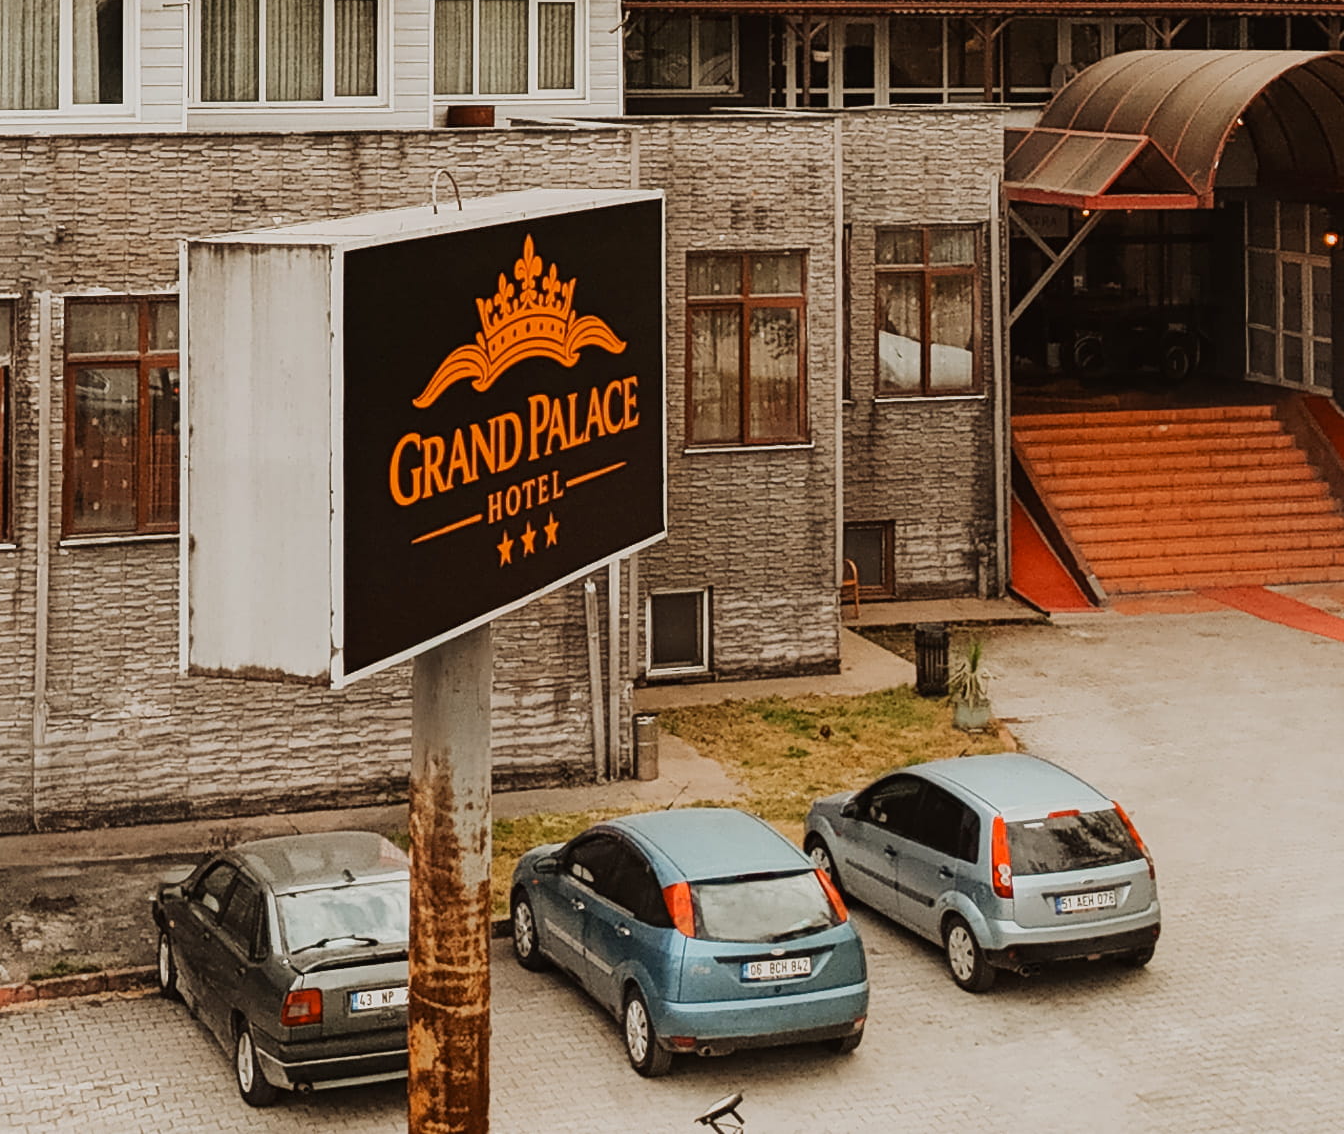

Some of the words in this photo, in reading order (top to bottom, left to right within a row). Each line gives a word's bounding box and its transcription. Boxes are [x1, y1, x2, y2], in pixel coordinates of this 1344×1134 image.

[390, 412, 523, 506] GRAND
[528, 375, 640, 461] PALACE
[488, 470, 563, 524] HOTEL
[1061, 897, 1073, 910] 51
[750, 964, 762, 976] 06
[769, 962, 787, 975] BCH
[791, 959, 808, 972] 842
[359, 993, 373, 1007] 43
